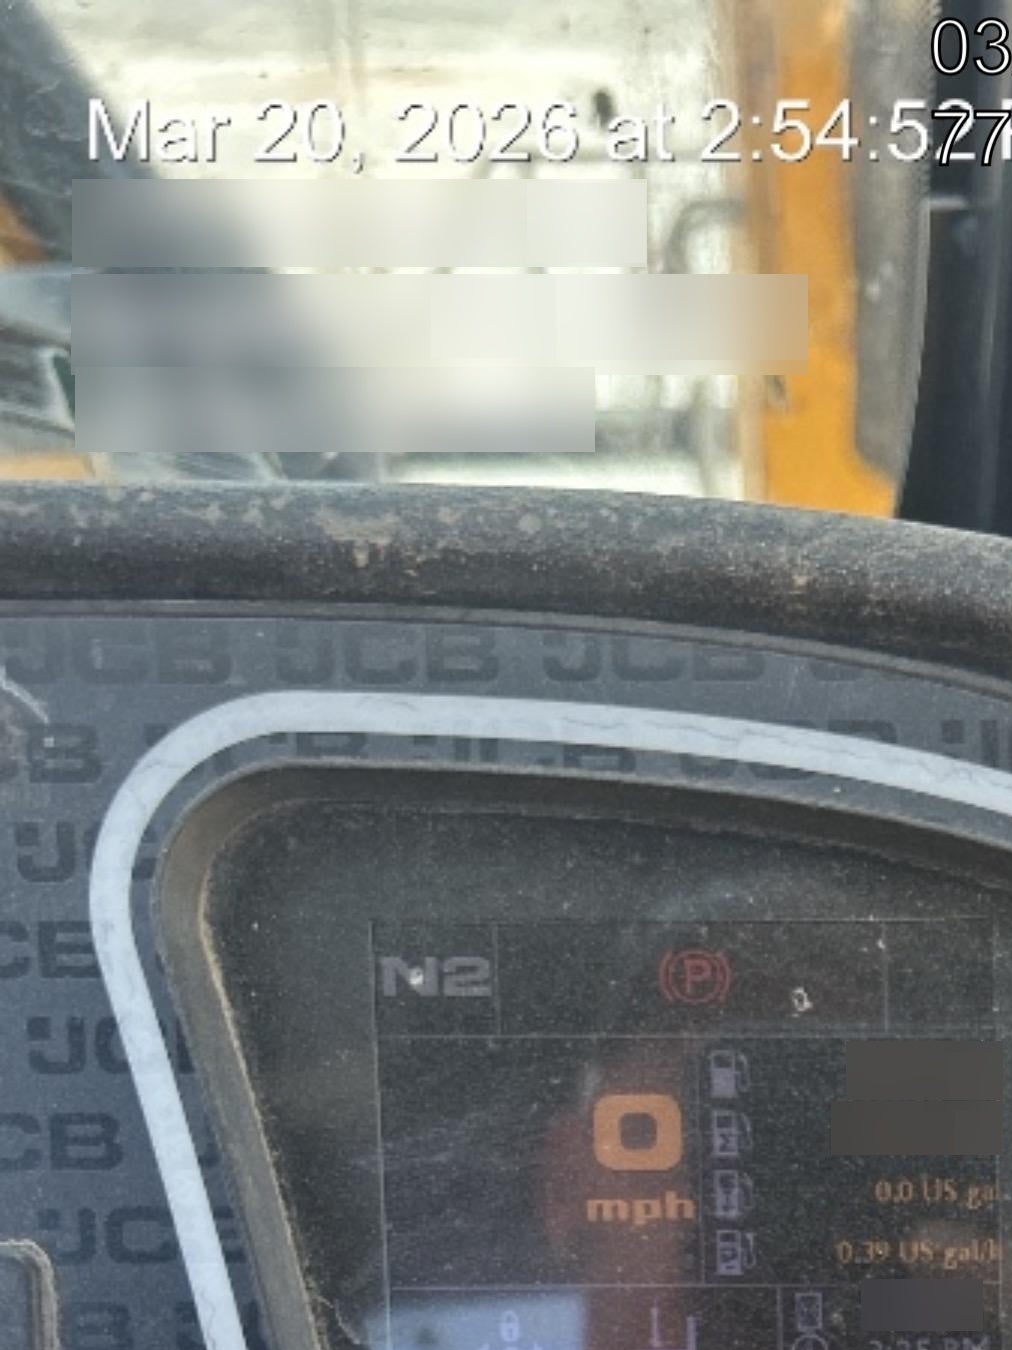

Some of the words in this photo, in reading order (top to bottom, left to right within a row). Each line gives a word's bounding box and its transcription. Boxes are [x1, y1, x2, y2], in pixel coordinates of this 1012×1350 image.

[380, 955, 492, 997] N2
[922, 1178, 958, 1202] US
[586, 1191, 695, 1225] mph
[899, 1239, 934, 1263] US
